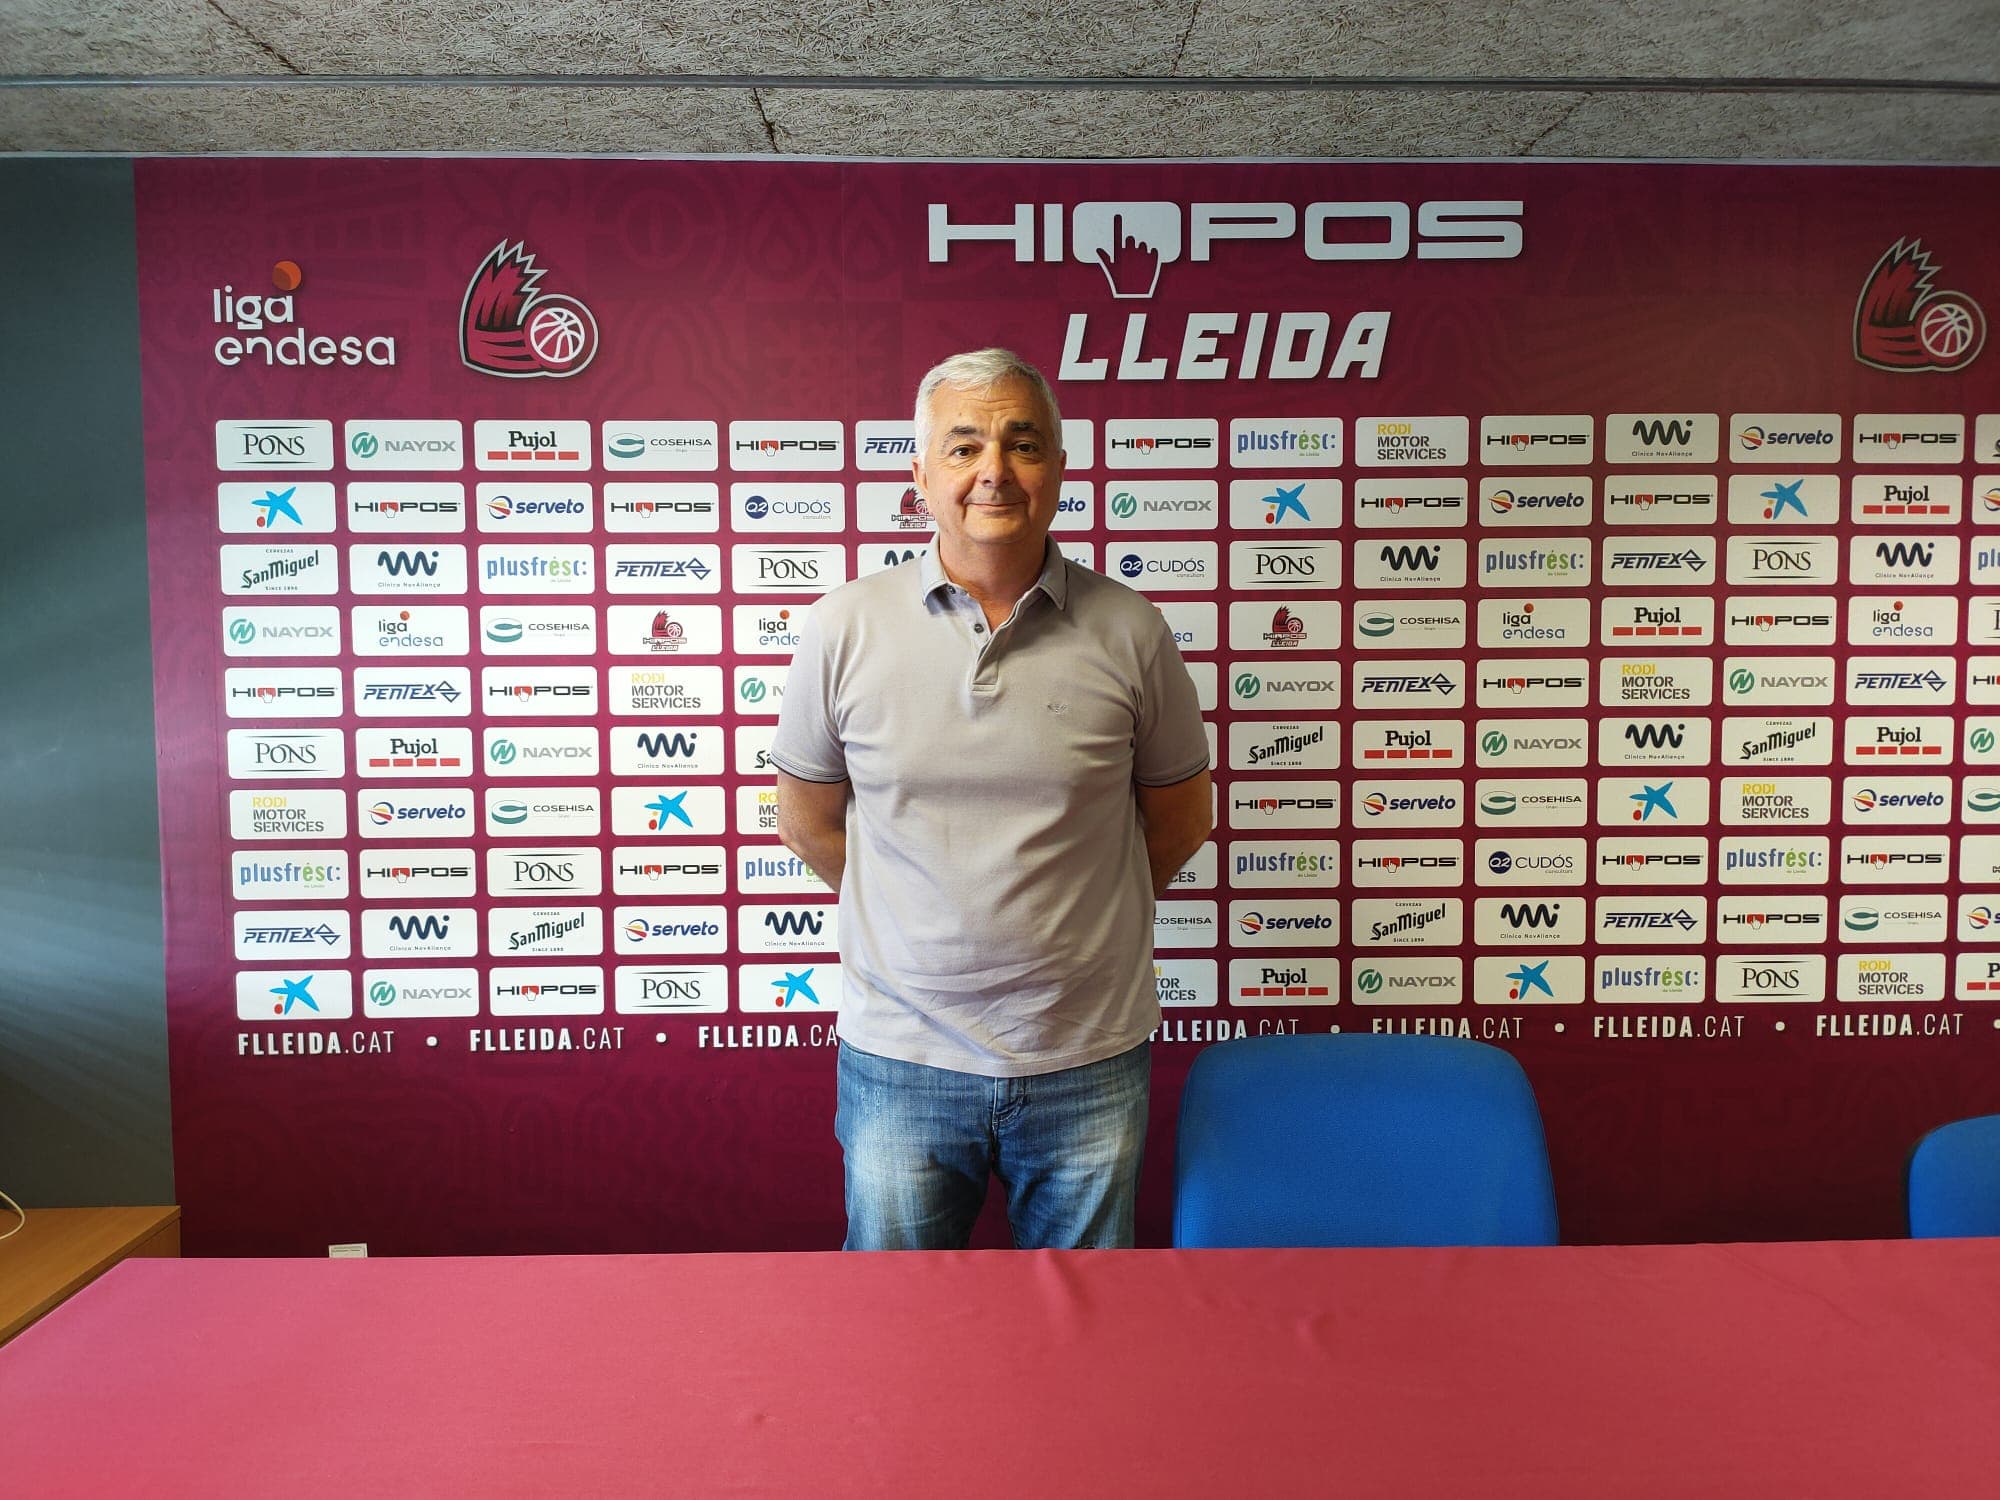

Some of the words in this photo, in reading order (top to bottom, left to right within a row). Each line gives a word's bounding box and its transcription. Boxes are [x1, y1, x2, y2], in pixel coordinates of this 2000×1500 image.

[213, 285, 294, 330] liga
[214, 328, 396, 366] endesa
[1058, 311, 1391, 380] LLEIDA
[1377, 423, 1412, 435] RODI
[508, 431, 558, 450] Pujol
[650, 438, 712, 446] COSEHISA
[1378, 436, 1430, 448] MOTOR
[1767, 429, 1833, 444] serveto
[242, 433, 305, 456] PONS
[384, 440, 456, 452] NAYOX
[1377, 448, 1447, 460] SERVICES
[1517, 492, 1584, 508] serveto
[1883, 485, 1930, 504] Pujol
[515, 498, 584, 514] serveto
[772, 500, 831, 514] CUDÓS
[1143, 500, 1212, 512] NAYOX
[1146, 557, 1205, 573] CUDÓS
[1255, 554, 1315, 576] PONS
[1752, 548, 1811, 571] PONS
[758, 557, 819, 580] PONS
[1399, 617, 1460, 625] COSEHISA
[1503, 611, 1532, 627] liga
[1633, 607, 1681, 626] Pujol
[1873, 608, 1902, 625] liga
[262, 626, 333, 638] NAYOX
[378, 618, 408, 635] liga
[528, 623, 590, 631] COSEHISA
[758, 618, 787, 633] liga
[1502, 625, 1565, 639] endesa
[1872, 623, 1933, 637] endesa
[379, 633, 443, 647] endesa
[759, 632, 800, 645] ende
[1622, 664, 1656, 675] RODI
[631, 673, 665, 684] RODI
[1622, 676, 1674, 687] MOTOR
[1760, 676, 1829, 688] NAYOX
[632, 685, 684, 696] MOTOR
[1266, 680, 1336, 692] NAYOX
[1621, 688, 1690, 700] SERVICES
[632, 697, 701, 708] SERVICES
[1385, 730, 1432, 749] Pujol
[1876, 726, 1922, 745] Pujol
[390, 738, 439, 757] Pujol
[1513, 738, 1582, 750] NAYOX
[254, 742, 316, 764] PONS
[523, 747, 592, 758] NAYOX
[1742, 783, 1776, 795] RODI
[252, 797, 287, 808] RODI
[1389, 795, 1456, 810] serveto
[1521, 795, 1583, 803] COSEHISA
[1742, 795, 1793, 807] MOTOR
[1879, 792, 1944, 807] serveto
[253, 809, 306, 820] MOTOR
[397, 804, 466, 819] serveto
[533, 804, 595, 812] COSEHISA
[1741, 807, 1809, 819] SERVICES
[254, 821, 324, 833] SERVICES
[1515, 854, 1573, 869] CUDÓS
[513, 861, 574, 882] PONS
[1266, 914, 1332, 929] serveto
[1883, 911, 1942, 919] COSEHISA
[652, 921, 719, 936] serveto
[1858, 960, 1891, 971] RODI
[1261, 968, 1308, 986] Pujol
[1389, 976, 1456, 987] NAYOX
[1741, 967, 1799, 989] PONS
[1858, 972, 1908, 983] MOTOR
[402, 988, 472, 1000] NAYOX
[640, 978, 701, 1000] PONS
[1858, 984, 1924, 995] SERVICES
[238, 1031, 394, 1055] FLLEIDA.CAT
[470, 1027, 624, 1051] FLLEIDA.CAT
[698, 1024, 838, 1048] FLLEIDA.CA
[1594, 1015, 1744, 1038] FLLEIDA.CAT
[1816, 1013, 1963, 1036] FLLEIDA.CAT
